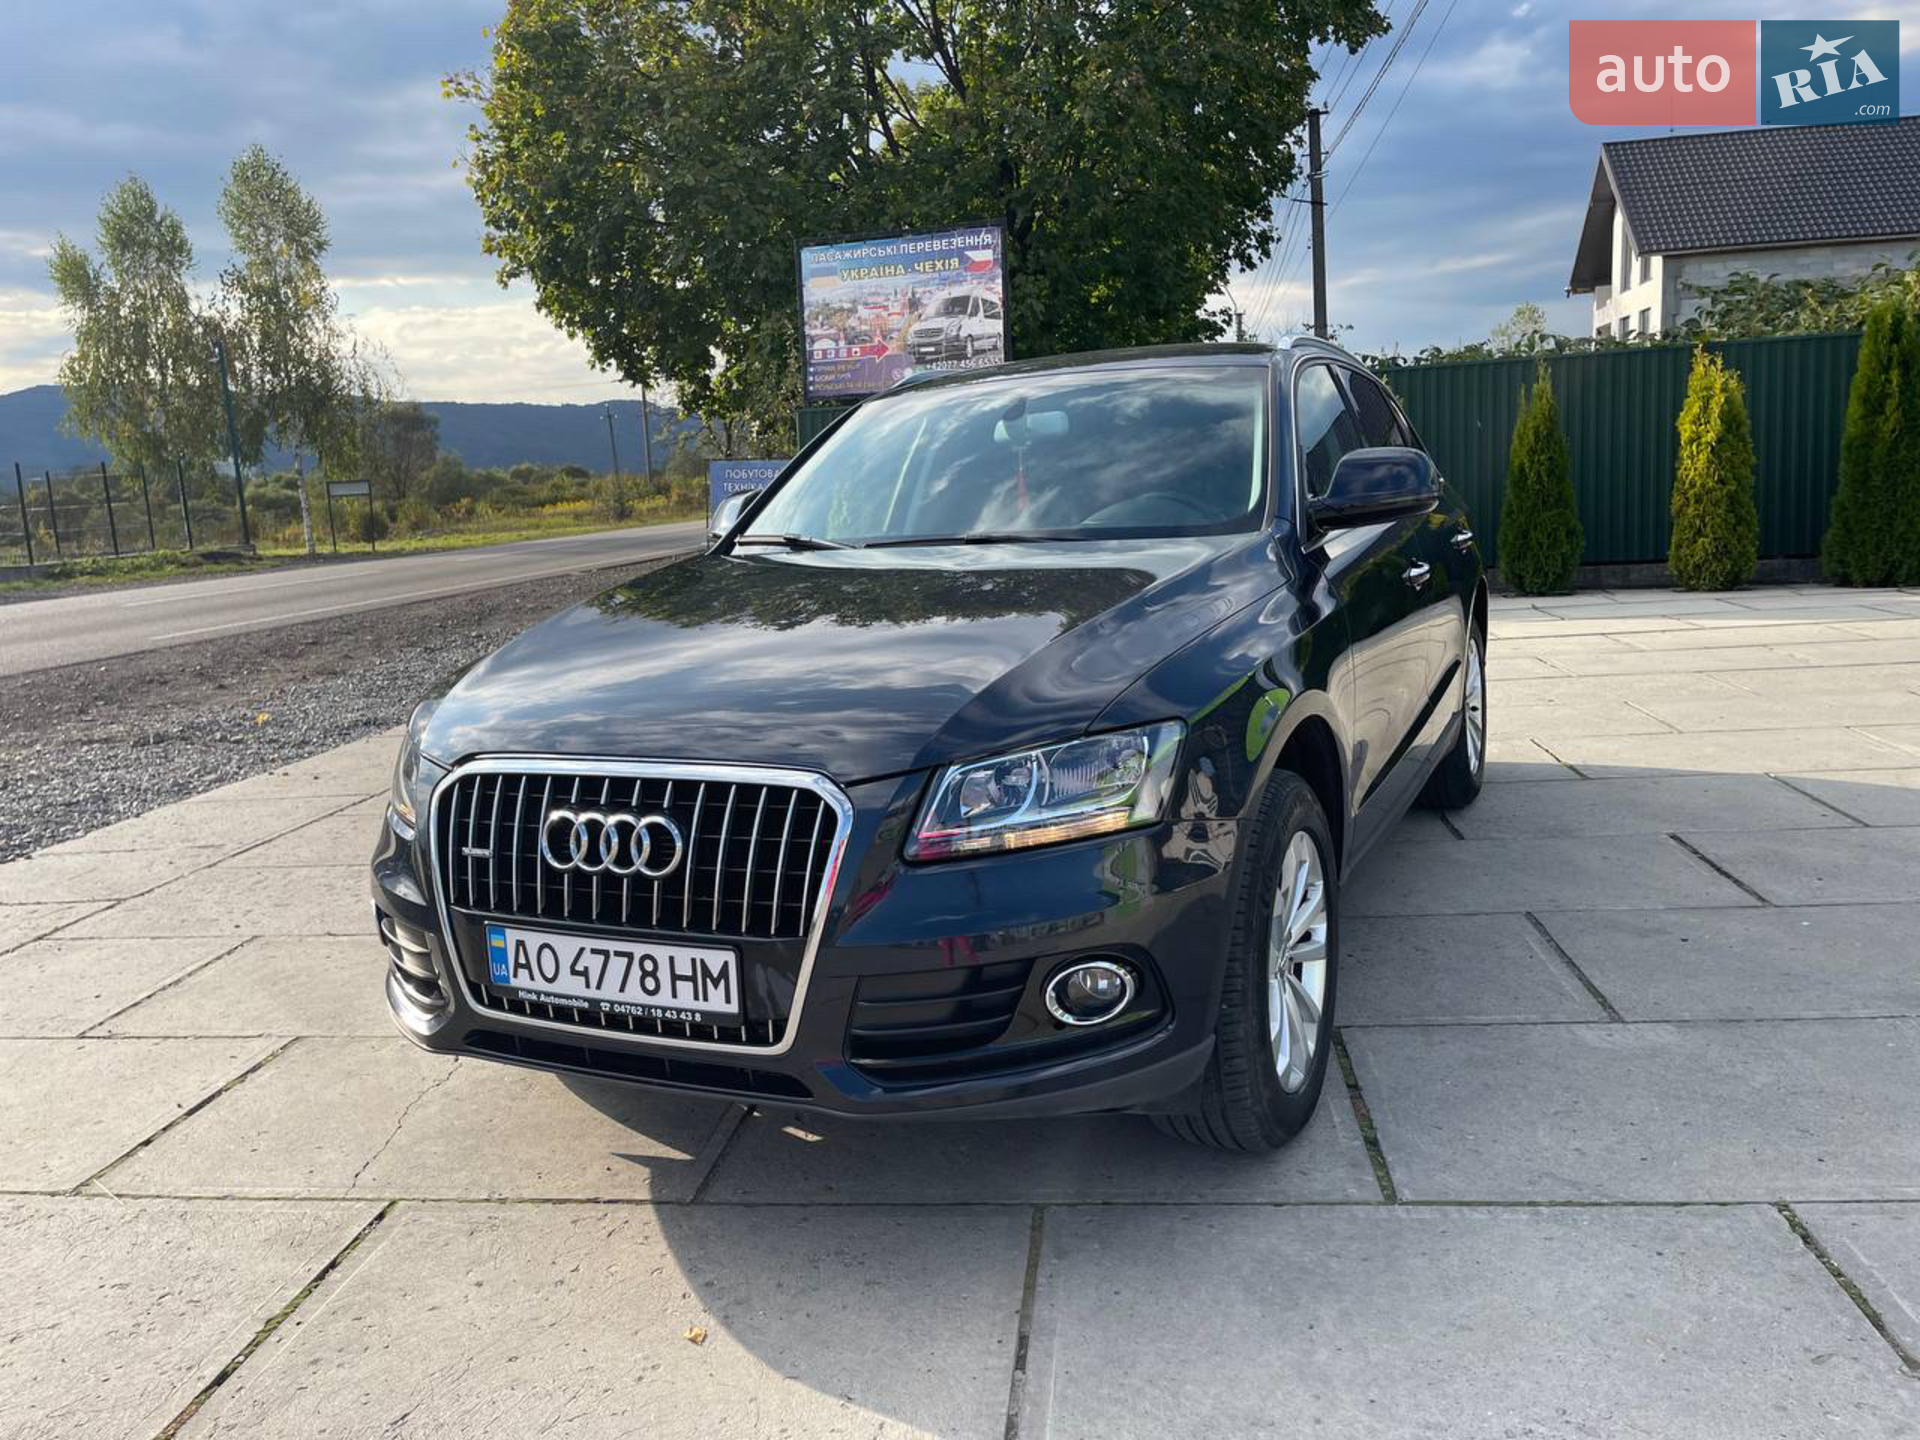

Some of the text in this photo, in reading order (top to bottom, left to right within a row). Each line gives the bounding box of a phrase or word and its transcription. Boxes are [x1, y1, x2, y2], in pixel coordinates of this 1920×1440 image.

[810, 233, 992, 263] ПАСАЖИРСЬКІ ПЕРЕВЕЗЕННЯ
[840, 264, 906, 281] УКРАЇНА
[914, 257, 960, 274] ЧЕХІЯ
[493, 961, 508, 978] UA
[512, 939, 732, 1005] AO 4778 HM
[539, 992, 589, 1009] Automobile
[613, 1004, 643, 1016] 04762
[651, 1008, 663, 1018] 18
[665, 1010, 678, 1020] 43
[680, 1011, 693, 1021] 43
[694, 1012, 702, 1022] 8
